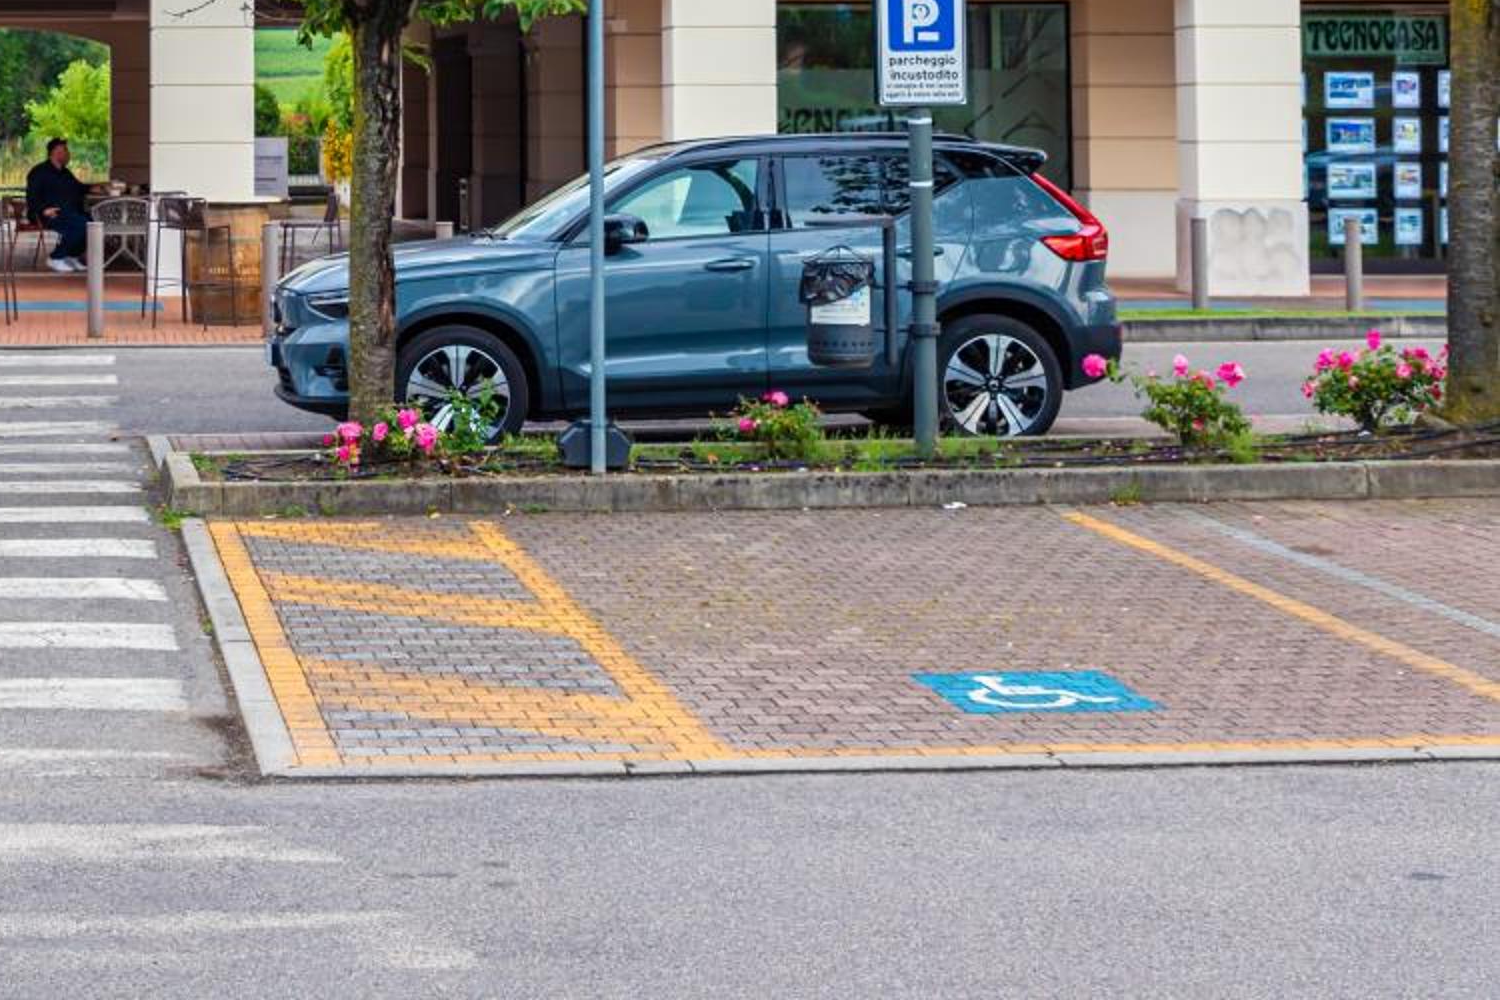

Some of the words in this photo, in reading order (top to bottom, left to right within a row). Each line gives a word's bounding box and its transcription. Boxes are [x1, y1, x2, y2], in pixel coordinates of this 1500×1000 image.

[1307, 19, 1440, 51] TECNOCASA
[889, 55, 957, 68] parcheggio
[890, 69, 960, 81] incustodito
